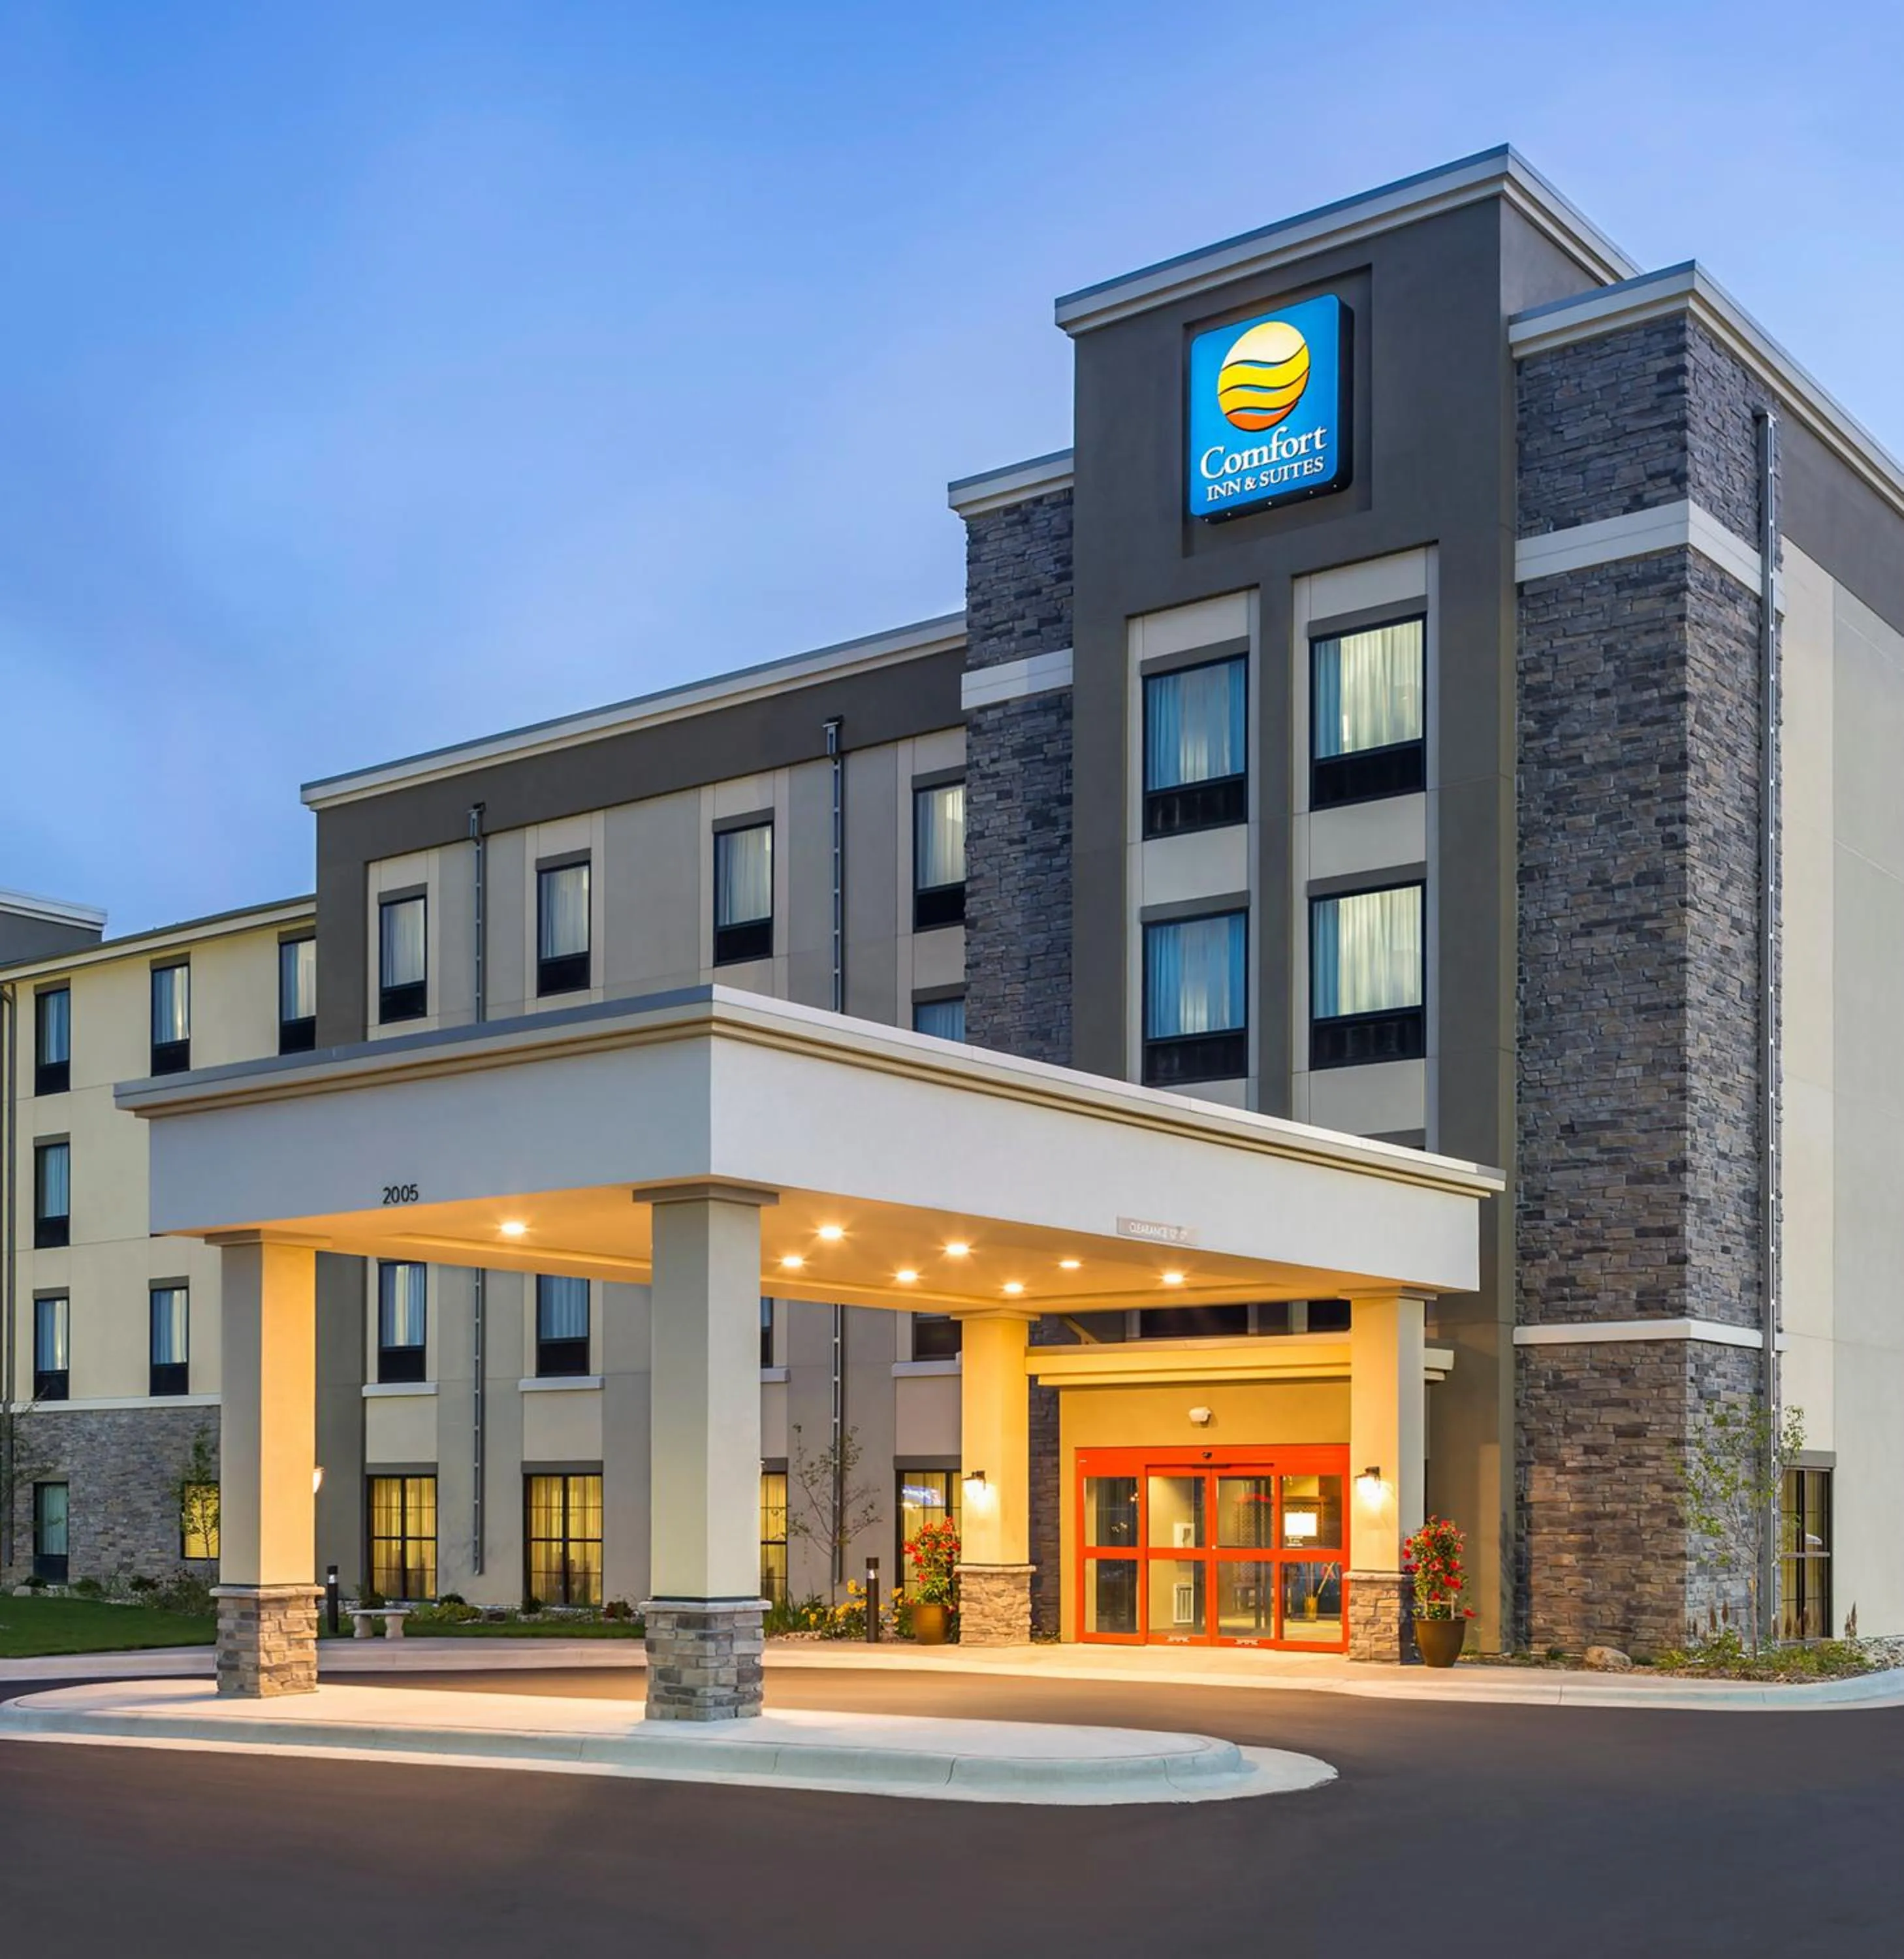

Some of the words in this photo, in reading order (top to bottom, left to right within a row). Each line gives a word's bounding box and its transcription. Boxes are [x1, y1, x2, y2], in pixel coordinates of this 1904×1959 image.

[1200, 426, 1327, 479] Comfort
[1206, 477, 1241, 502] INN
[1245, 476, 1258, 490] &
[1260, 456, 1325, 487] SUITES
[383, 1183, 419, 1205] 2005
